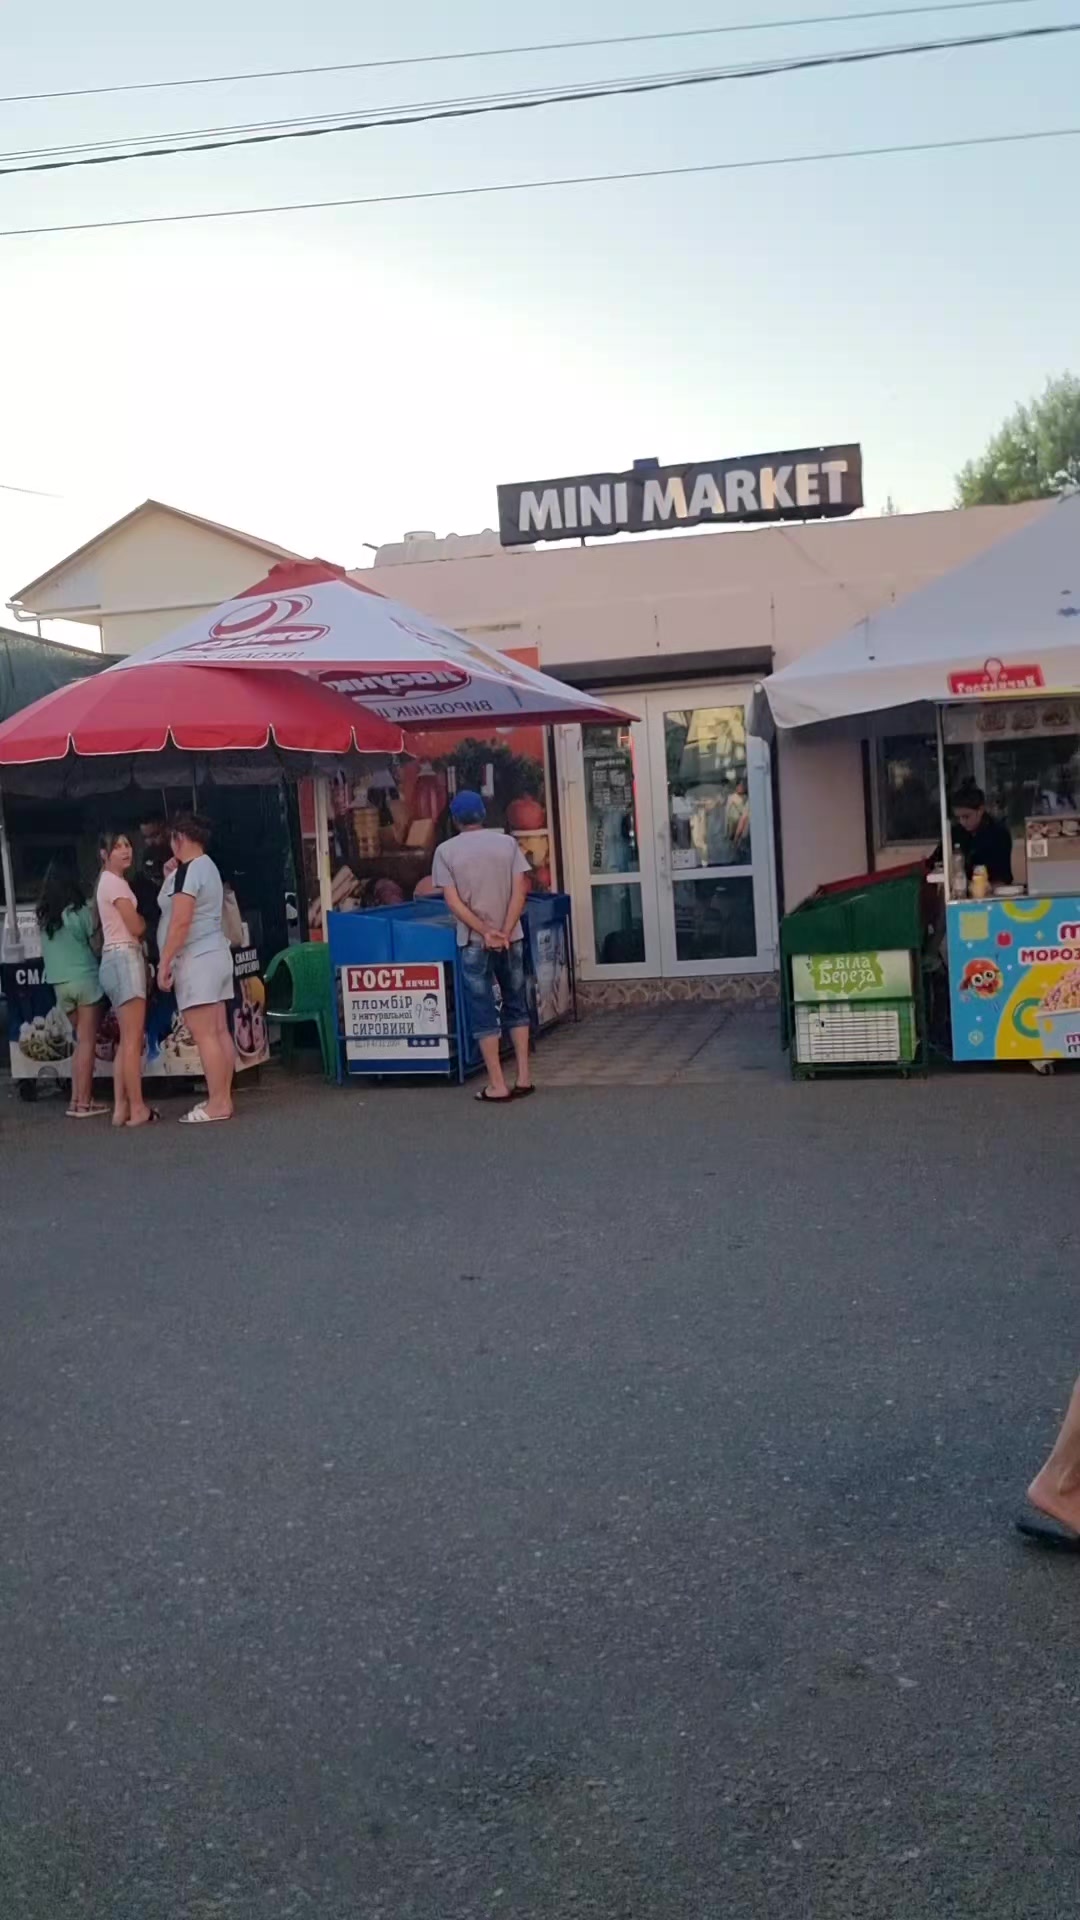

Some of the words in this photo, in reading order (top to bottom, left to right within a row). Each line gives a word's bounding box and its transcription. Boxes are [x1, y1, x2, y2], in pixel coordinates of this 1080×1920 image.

[518, 481, 629, 532] MINI
[641, 460, 849, 520] MARKET
[352, 1022, 415, 1036] СИРОВИНИ
